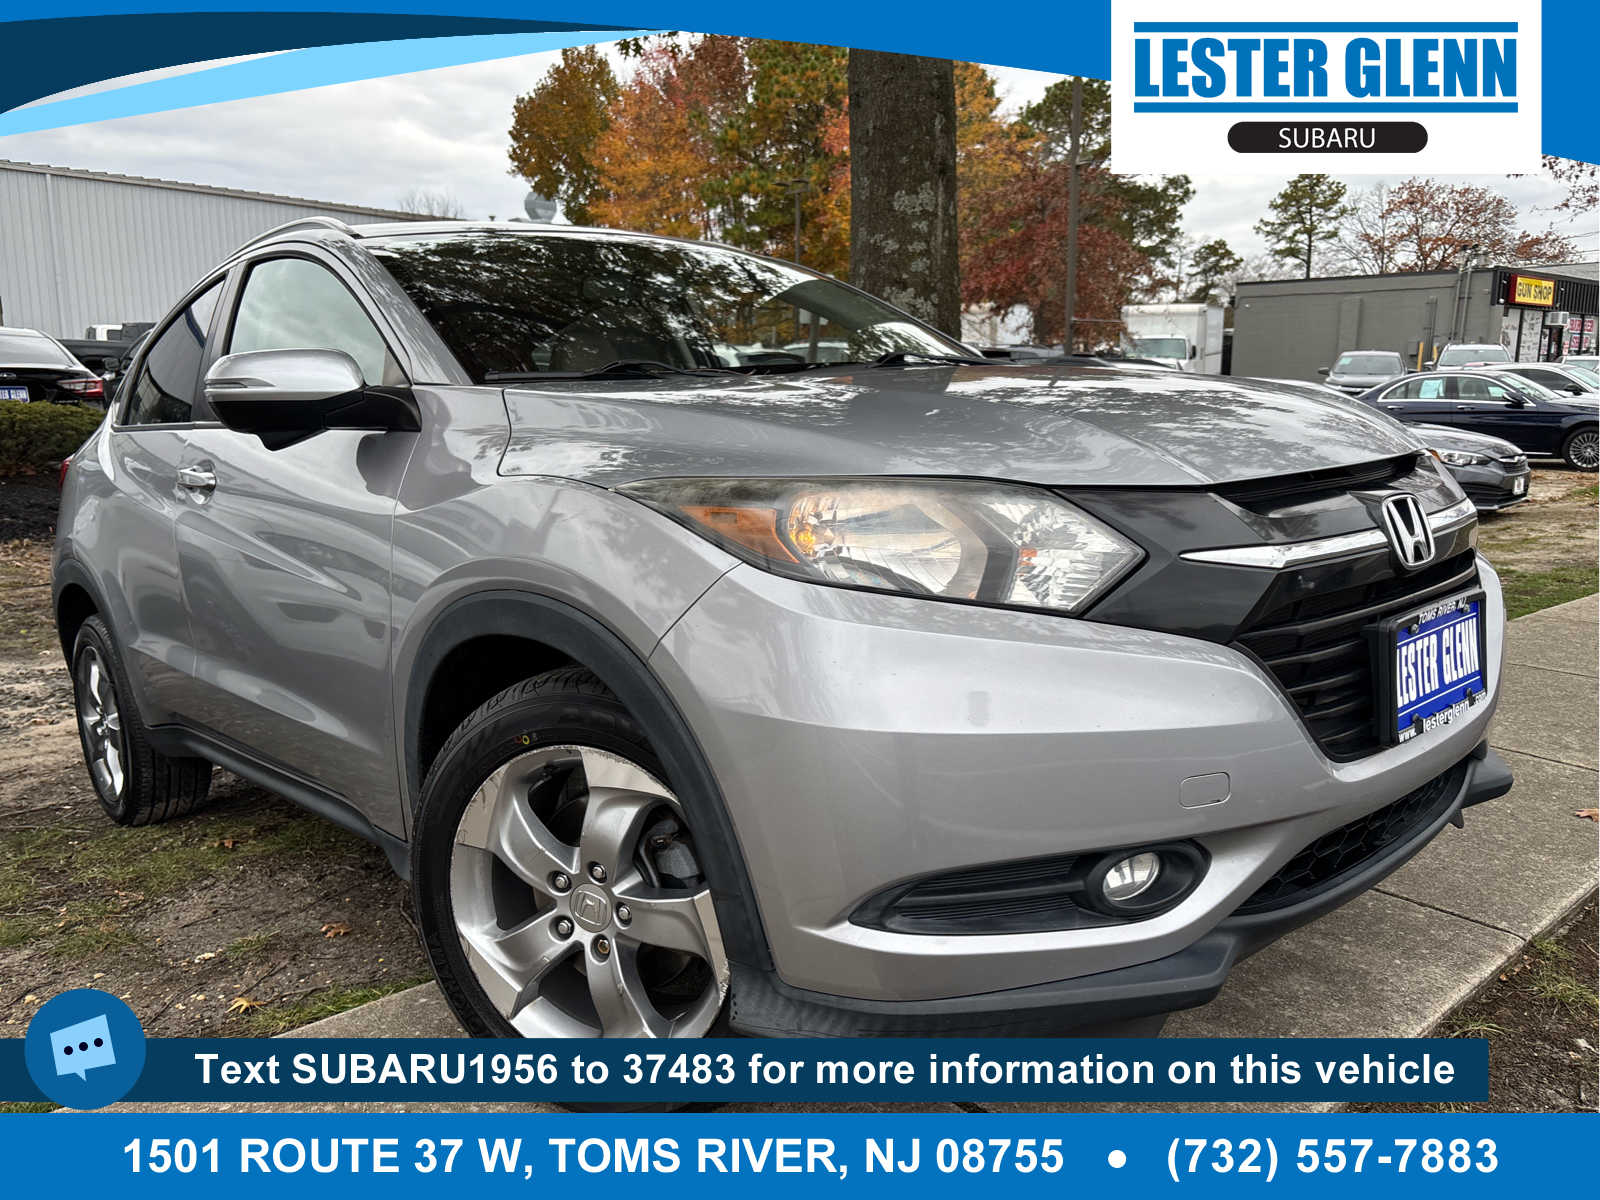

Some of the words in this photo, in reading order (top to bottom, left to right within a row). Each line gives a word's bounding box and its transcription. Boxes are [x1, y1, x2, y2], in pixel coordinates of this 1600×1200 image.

[1517, 282, 1532, 297] GUN
[1533, 285, 1552, 300] SHOP
[1419, 608, 1437, 625] TOMS
[1396, 633, 1440, 708] LESTER
[1442, 616, 1480, 685] GLENN
